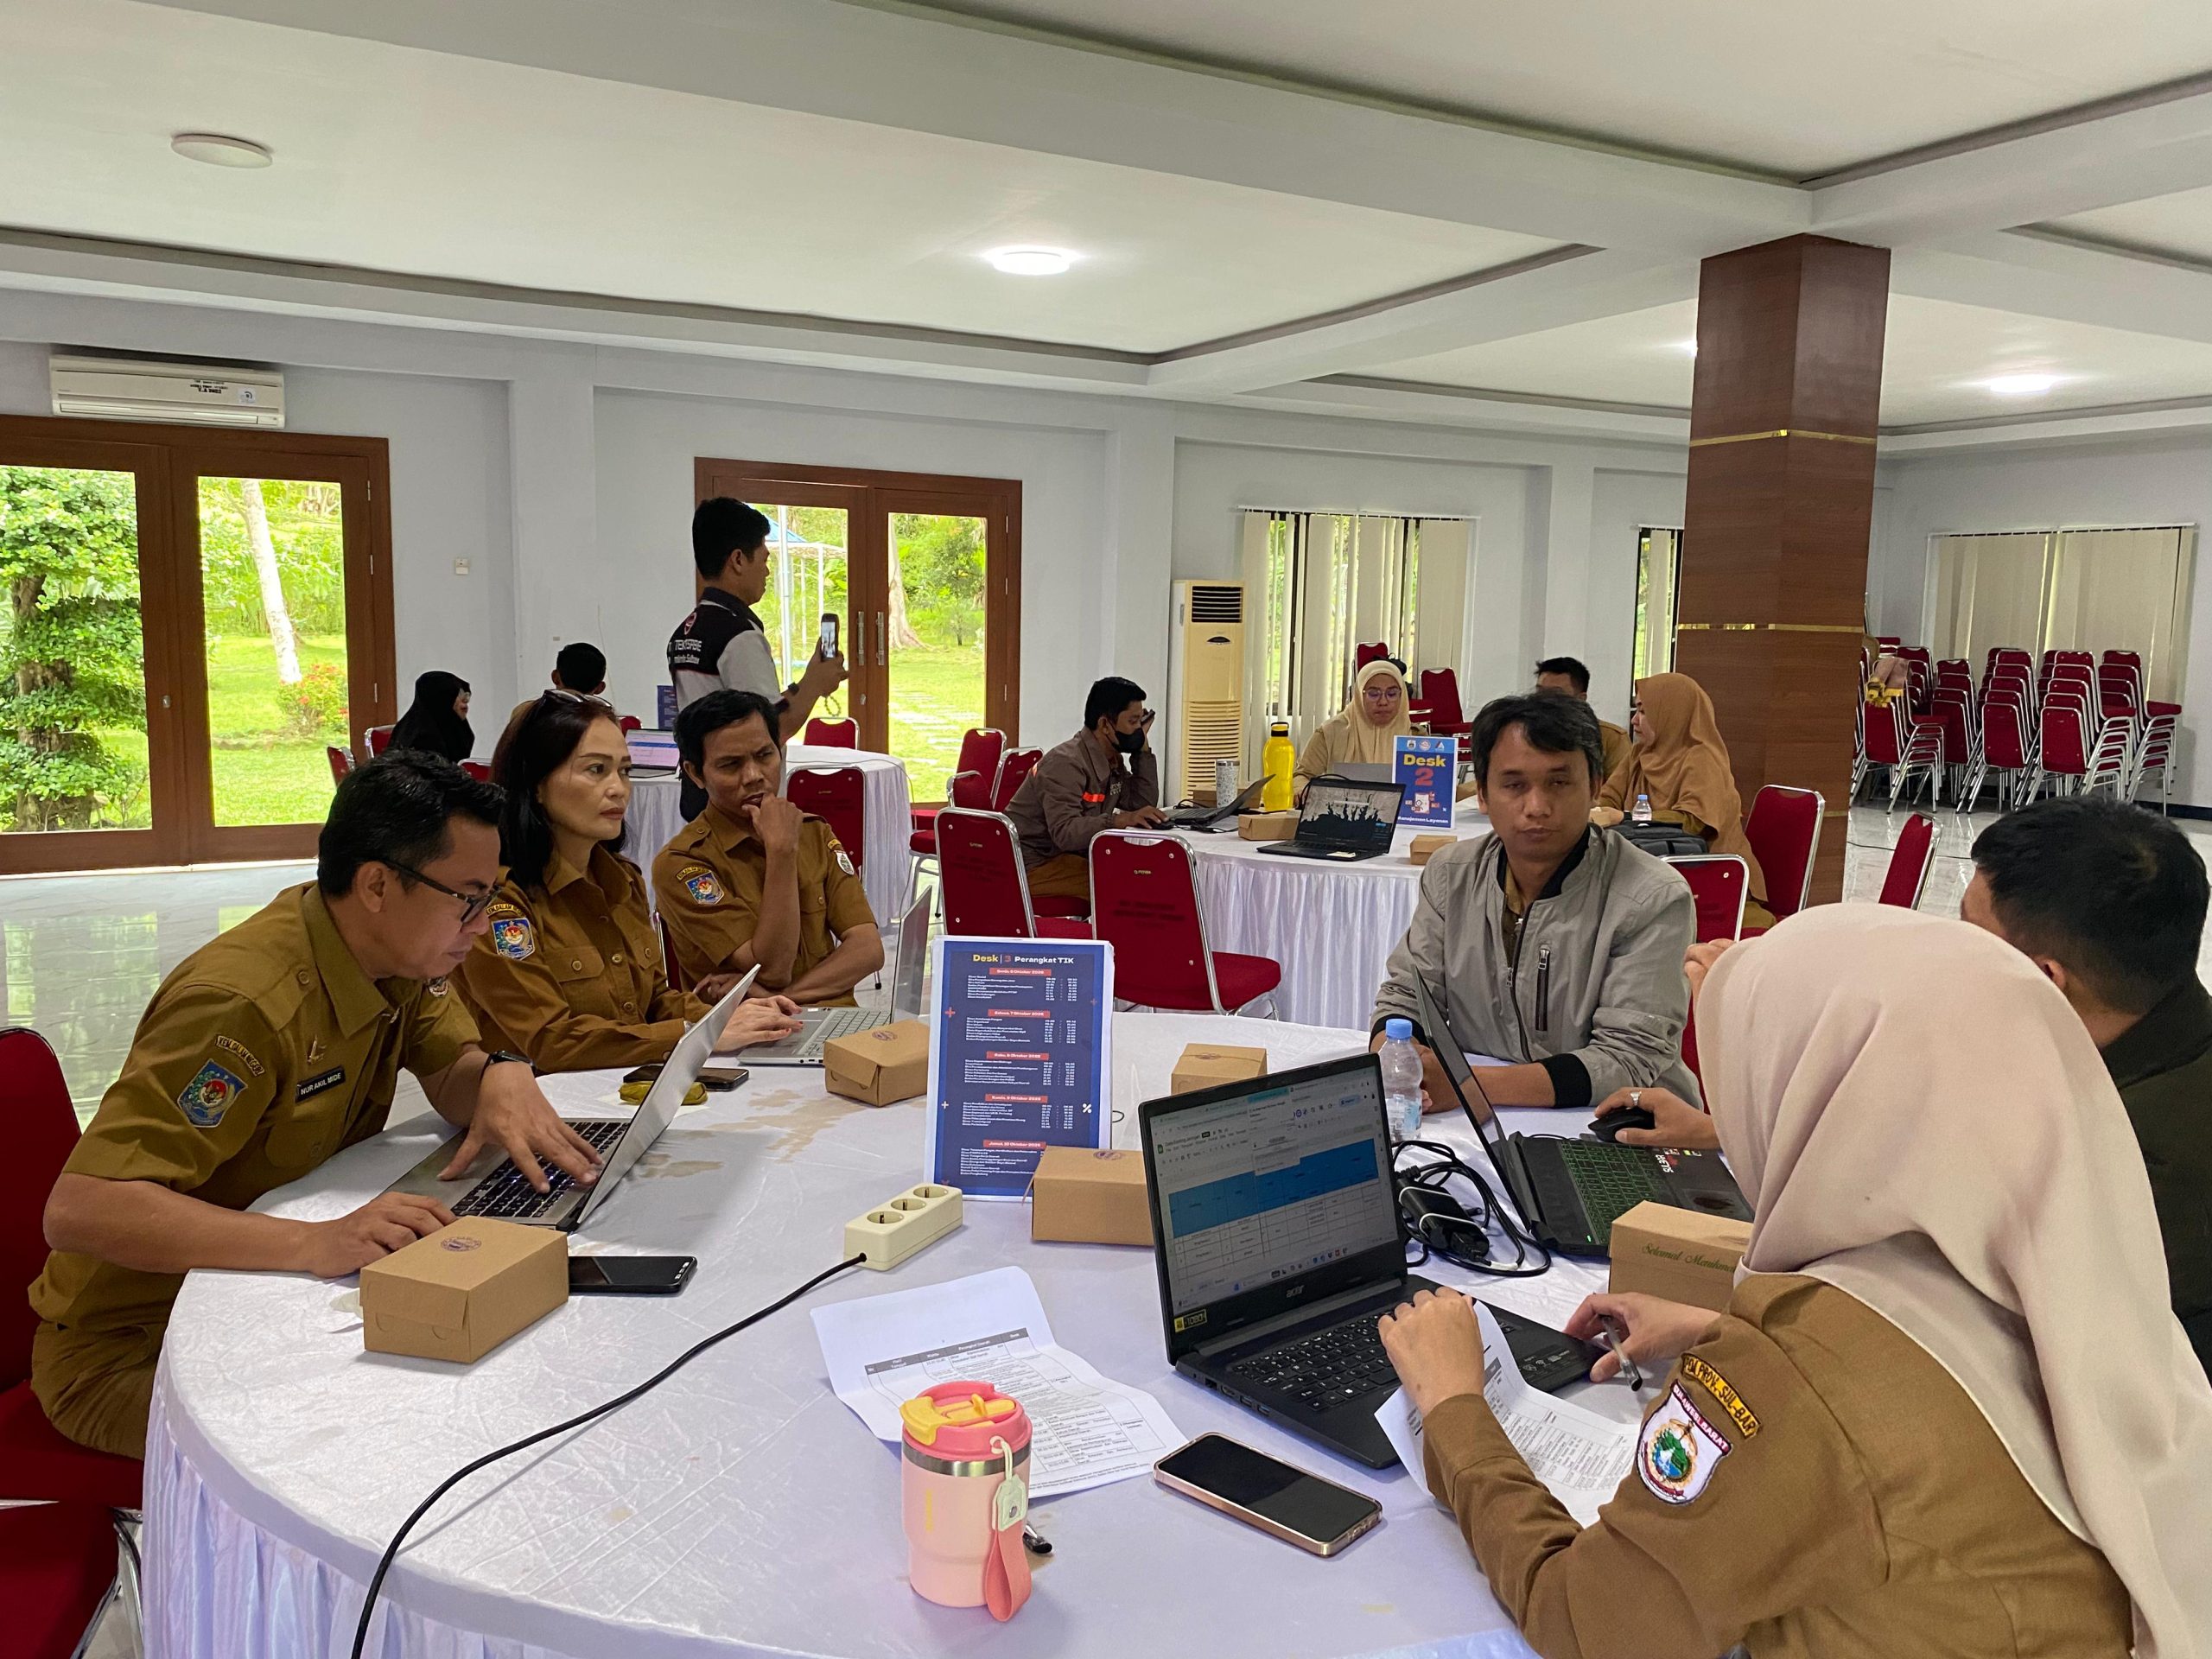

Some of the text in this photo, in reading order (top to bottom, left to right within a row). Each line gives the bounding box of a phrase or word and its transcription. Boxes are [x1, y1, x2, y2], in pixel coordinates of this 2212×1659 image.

[1404, 754, 1446, 767] Desk
[1415, 768, 1433, 786] 2
[973, 954, 999, 962] Desk
[1014, 956, 1056, 964] Perangkat
[301, 1073, 341, 1095] NUR AKIL MIDE
[1643, 1243, 1683, 1260] Selamat
[1287, 1285, 1305, 1298] acer
[1719, 1385, 1756, 1432] SUL-BAR
[1673, 1385, 1729, 1452] SULAWESI BARAT
